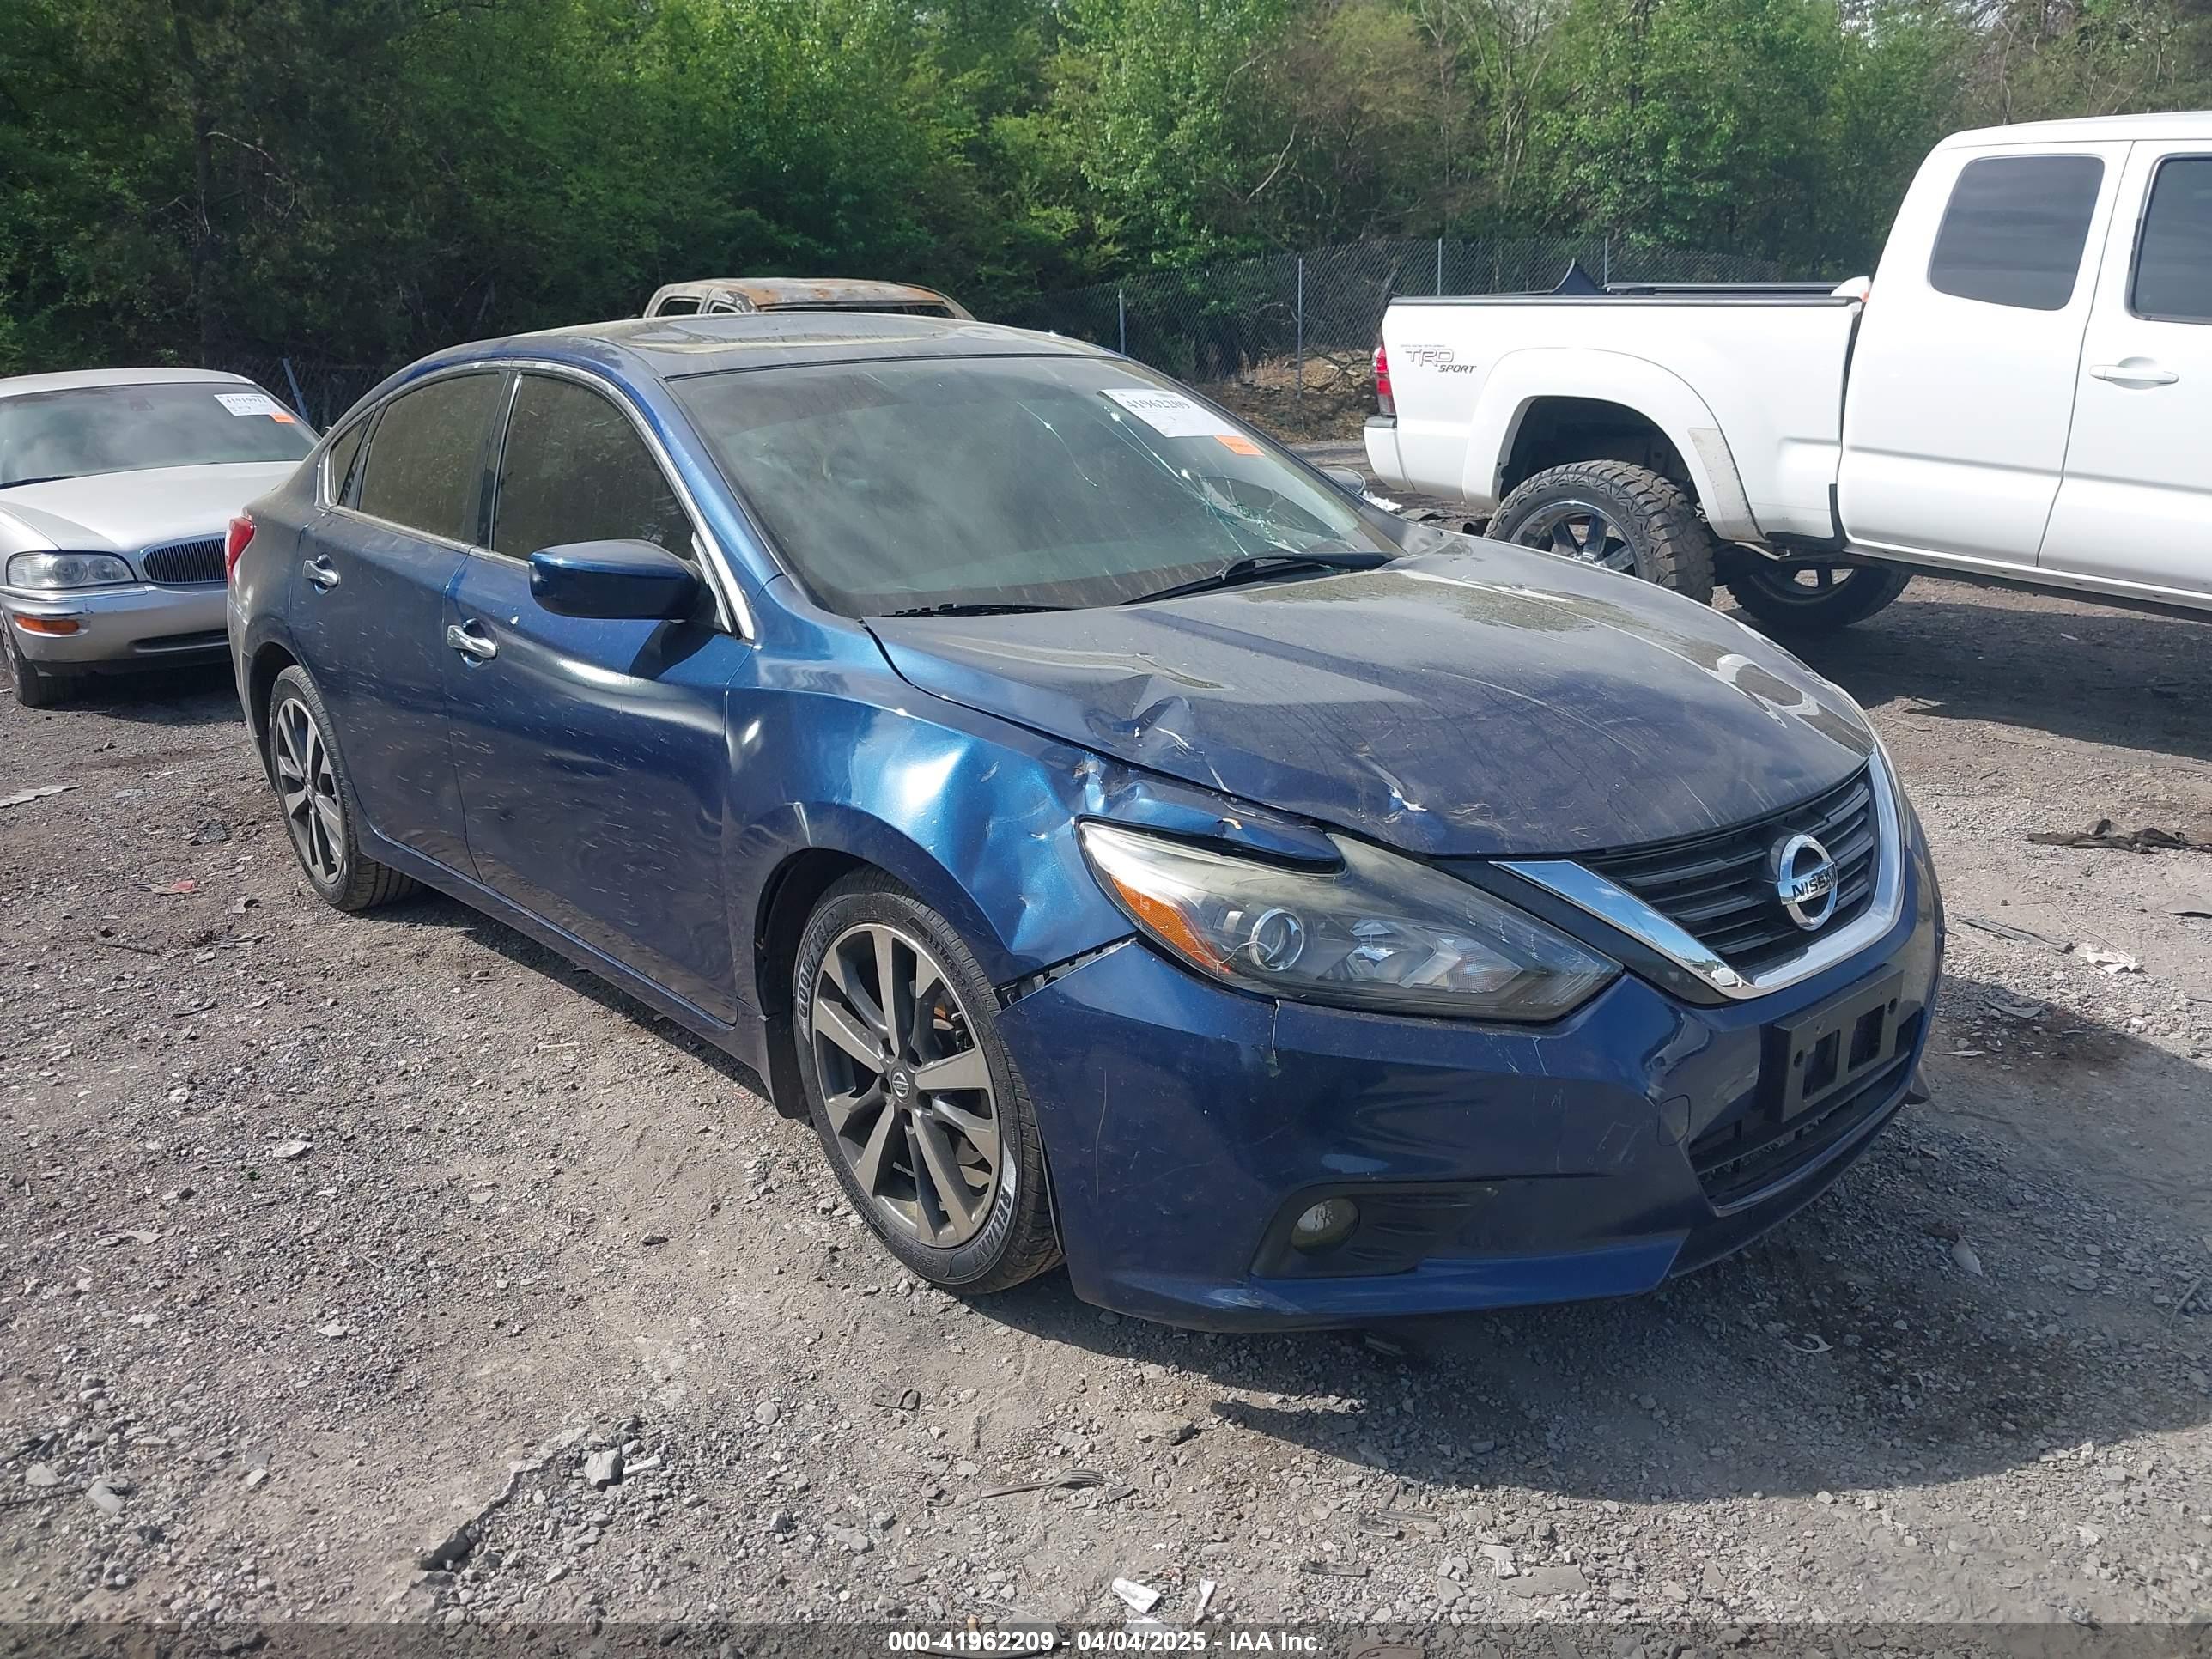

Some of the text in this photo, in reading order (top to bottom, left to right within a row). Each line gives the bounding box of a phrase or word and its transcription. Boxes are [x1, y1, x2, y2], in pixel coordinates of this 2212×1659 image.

[1405, 349, 1454, 367] TRD
[1438, 364, 1475, 374] SPORT
[1126, 399, 1190, 409] 41962209
[1791, 864, 1837, 898] NISSAN
[798, 911, 840, 1018] GOODYEAR
[971, 1185, 1012, 1267] RELIANT
